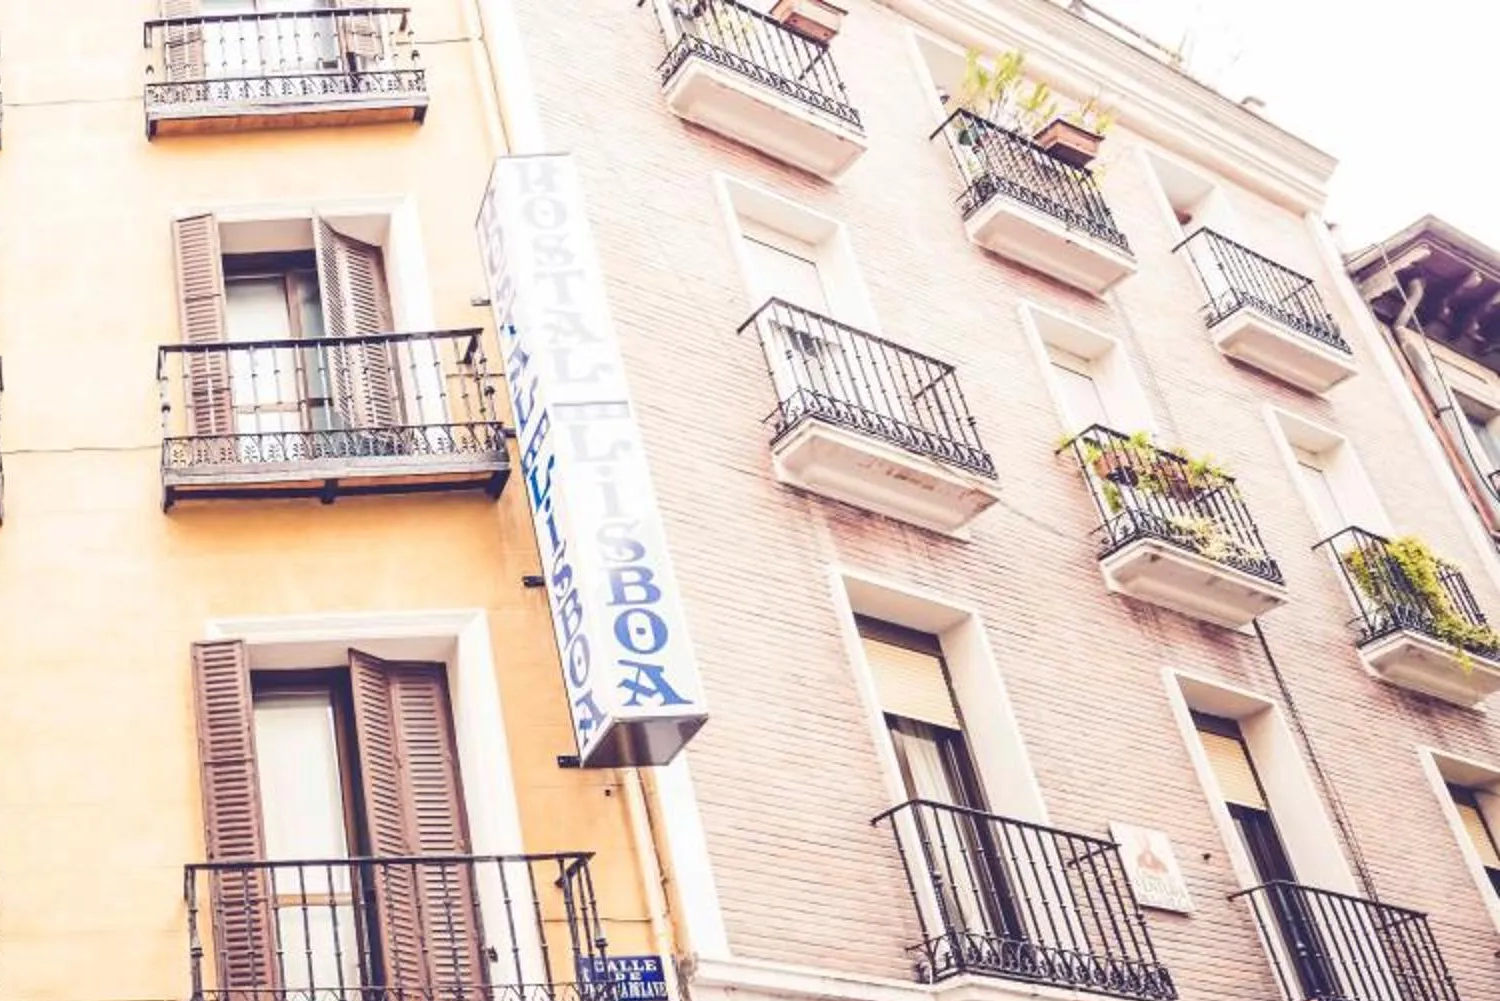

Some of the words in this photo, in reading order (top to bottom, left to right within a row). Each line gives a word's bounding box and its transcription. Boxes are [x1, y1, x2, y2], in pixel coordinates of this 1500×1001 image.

[512, 160, 615, 384] HOSTAL
[564, 424, 694, 706] LISBOA
[594, 959, 658, 974] CALLE
